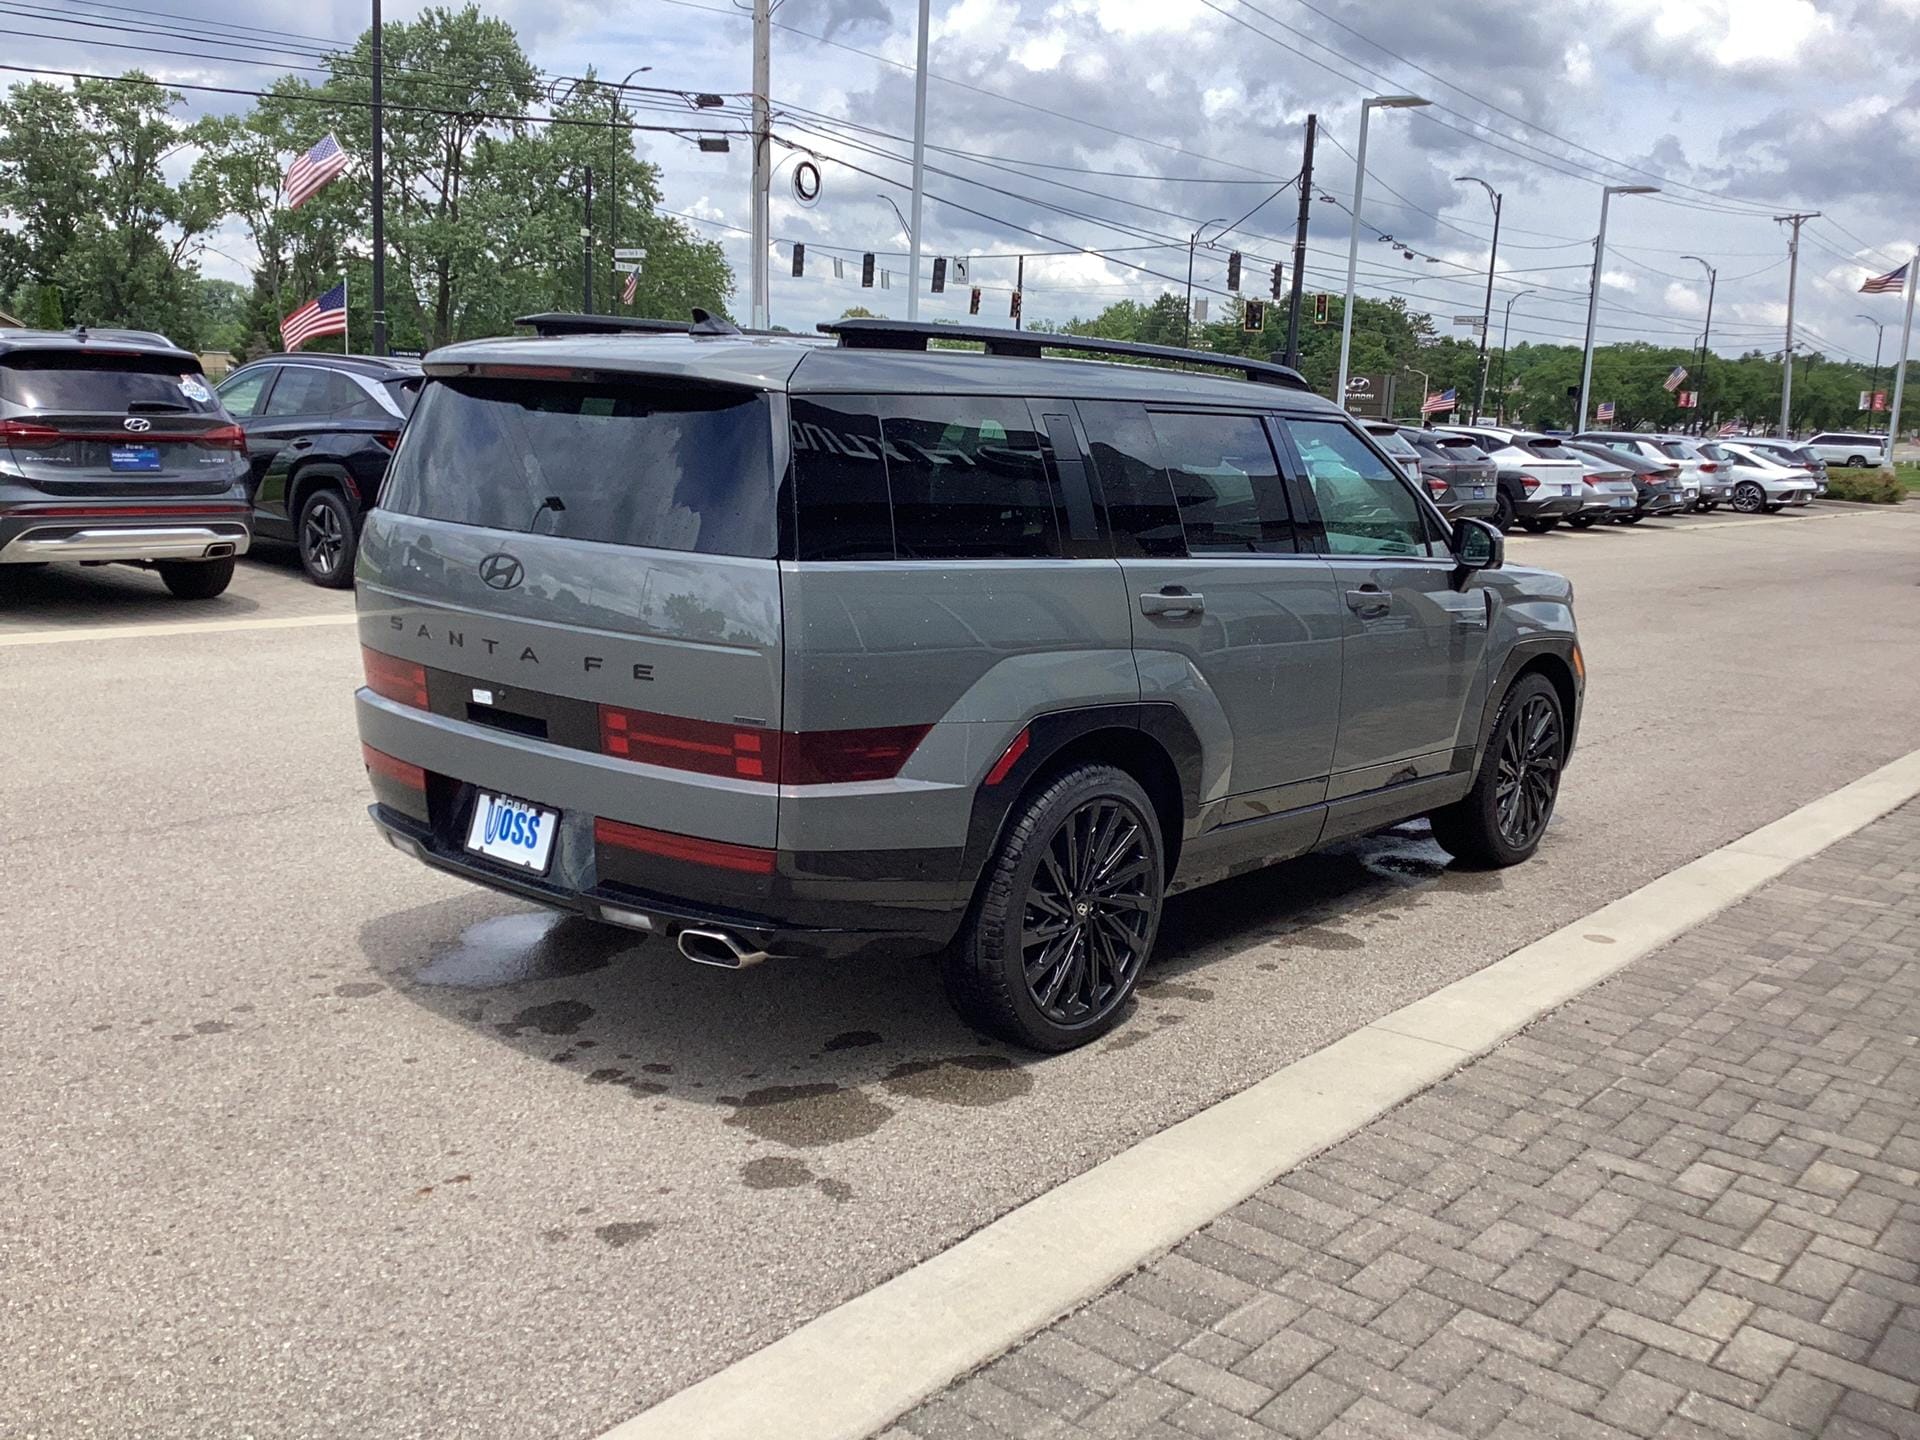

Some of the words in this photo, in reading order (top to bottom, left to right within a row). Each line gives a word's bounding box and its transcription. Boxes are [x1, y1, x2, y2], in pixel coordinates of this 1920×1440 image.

[390, 616, 540, 664] SANTA
[583, 656, 655, 682] FE
[484, 803, 541, 849] VOSS
